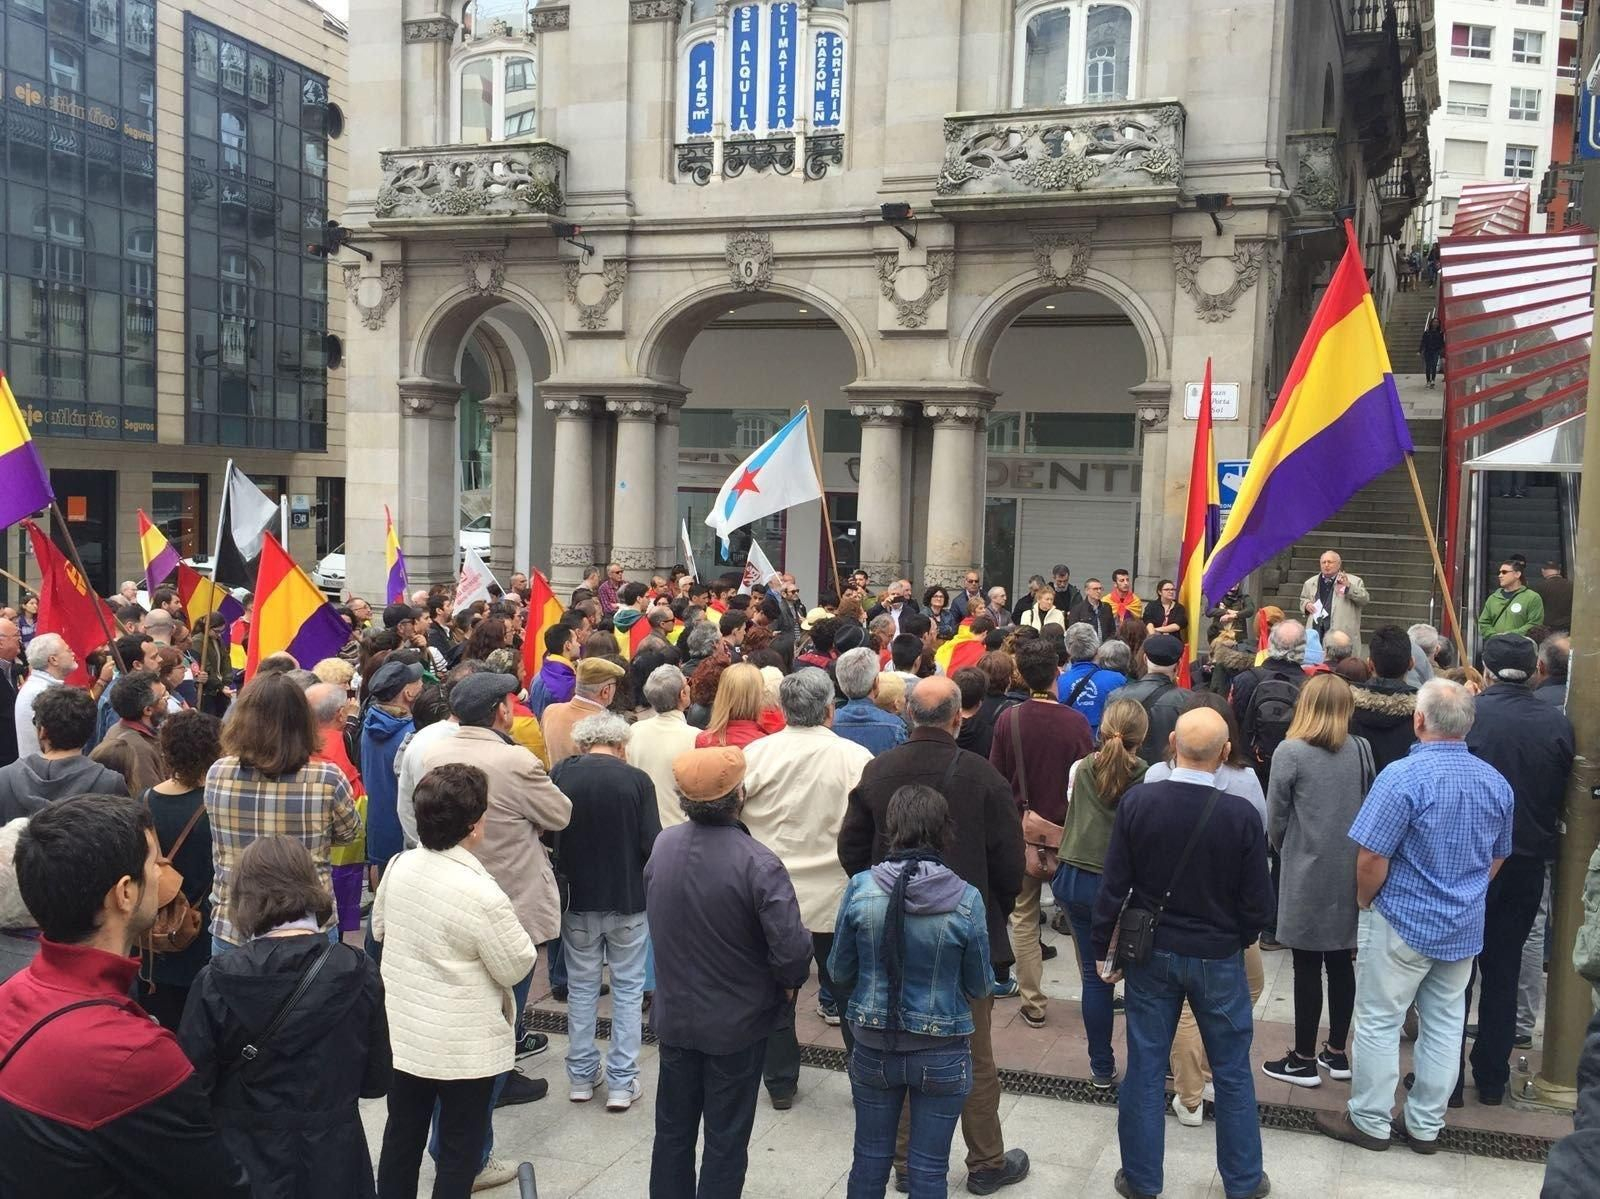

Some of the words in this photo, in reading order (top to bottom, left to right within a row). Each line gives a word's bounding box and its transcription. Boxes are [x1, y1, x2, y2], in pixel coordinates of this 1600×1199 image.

[741, 6, 751, 32] SE
[777, 4, 789, 129] CLIMATIZADA
[816, 37, 827, 91] RAZÓN
[830, 37, 842, 121] PORTERÍA
[15, 83, 41, 106] eje
[695, 60, 708, 108] 145
[739, 40, 751, 131] ALQUILA
[815, 101, 825, 121] EN
[745, 261, 753, 277] 6
[124, 419, 154, 432] Seguros
